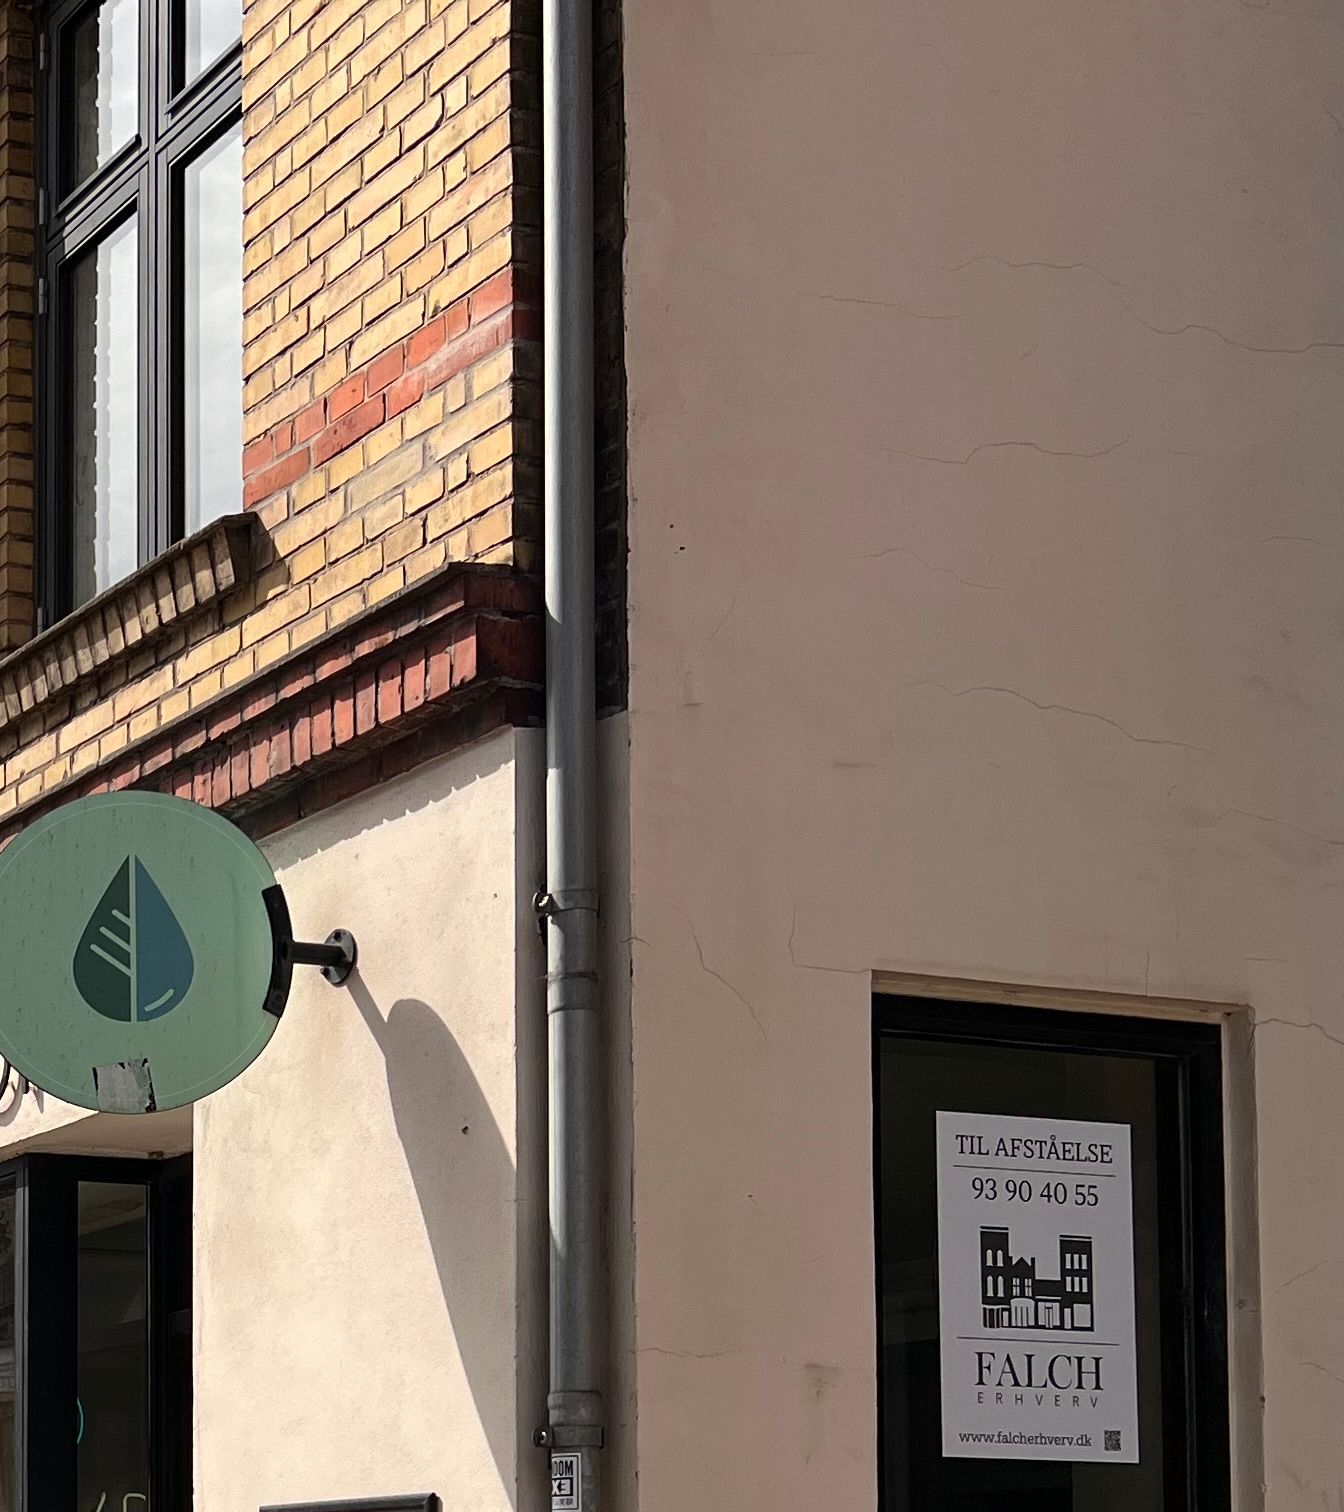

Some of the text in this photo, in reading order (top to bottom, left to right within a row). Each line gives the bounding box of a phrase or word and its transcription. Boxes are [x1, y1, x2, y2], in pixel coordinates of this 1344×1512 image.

[955, 1133, 1113, 1164] TIL AFSTÅELSE
[971, 1177, 1099, 1207] 93 90 40 55
[974, 1351, 1104, 1391] FALCH
[977, 1391, 1098, 1408] ERHVERV
[959, 1431, 1092, 1447] www.falcherhverv.dk
